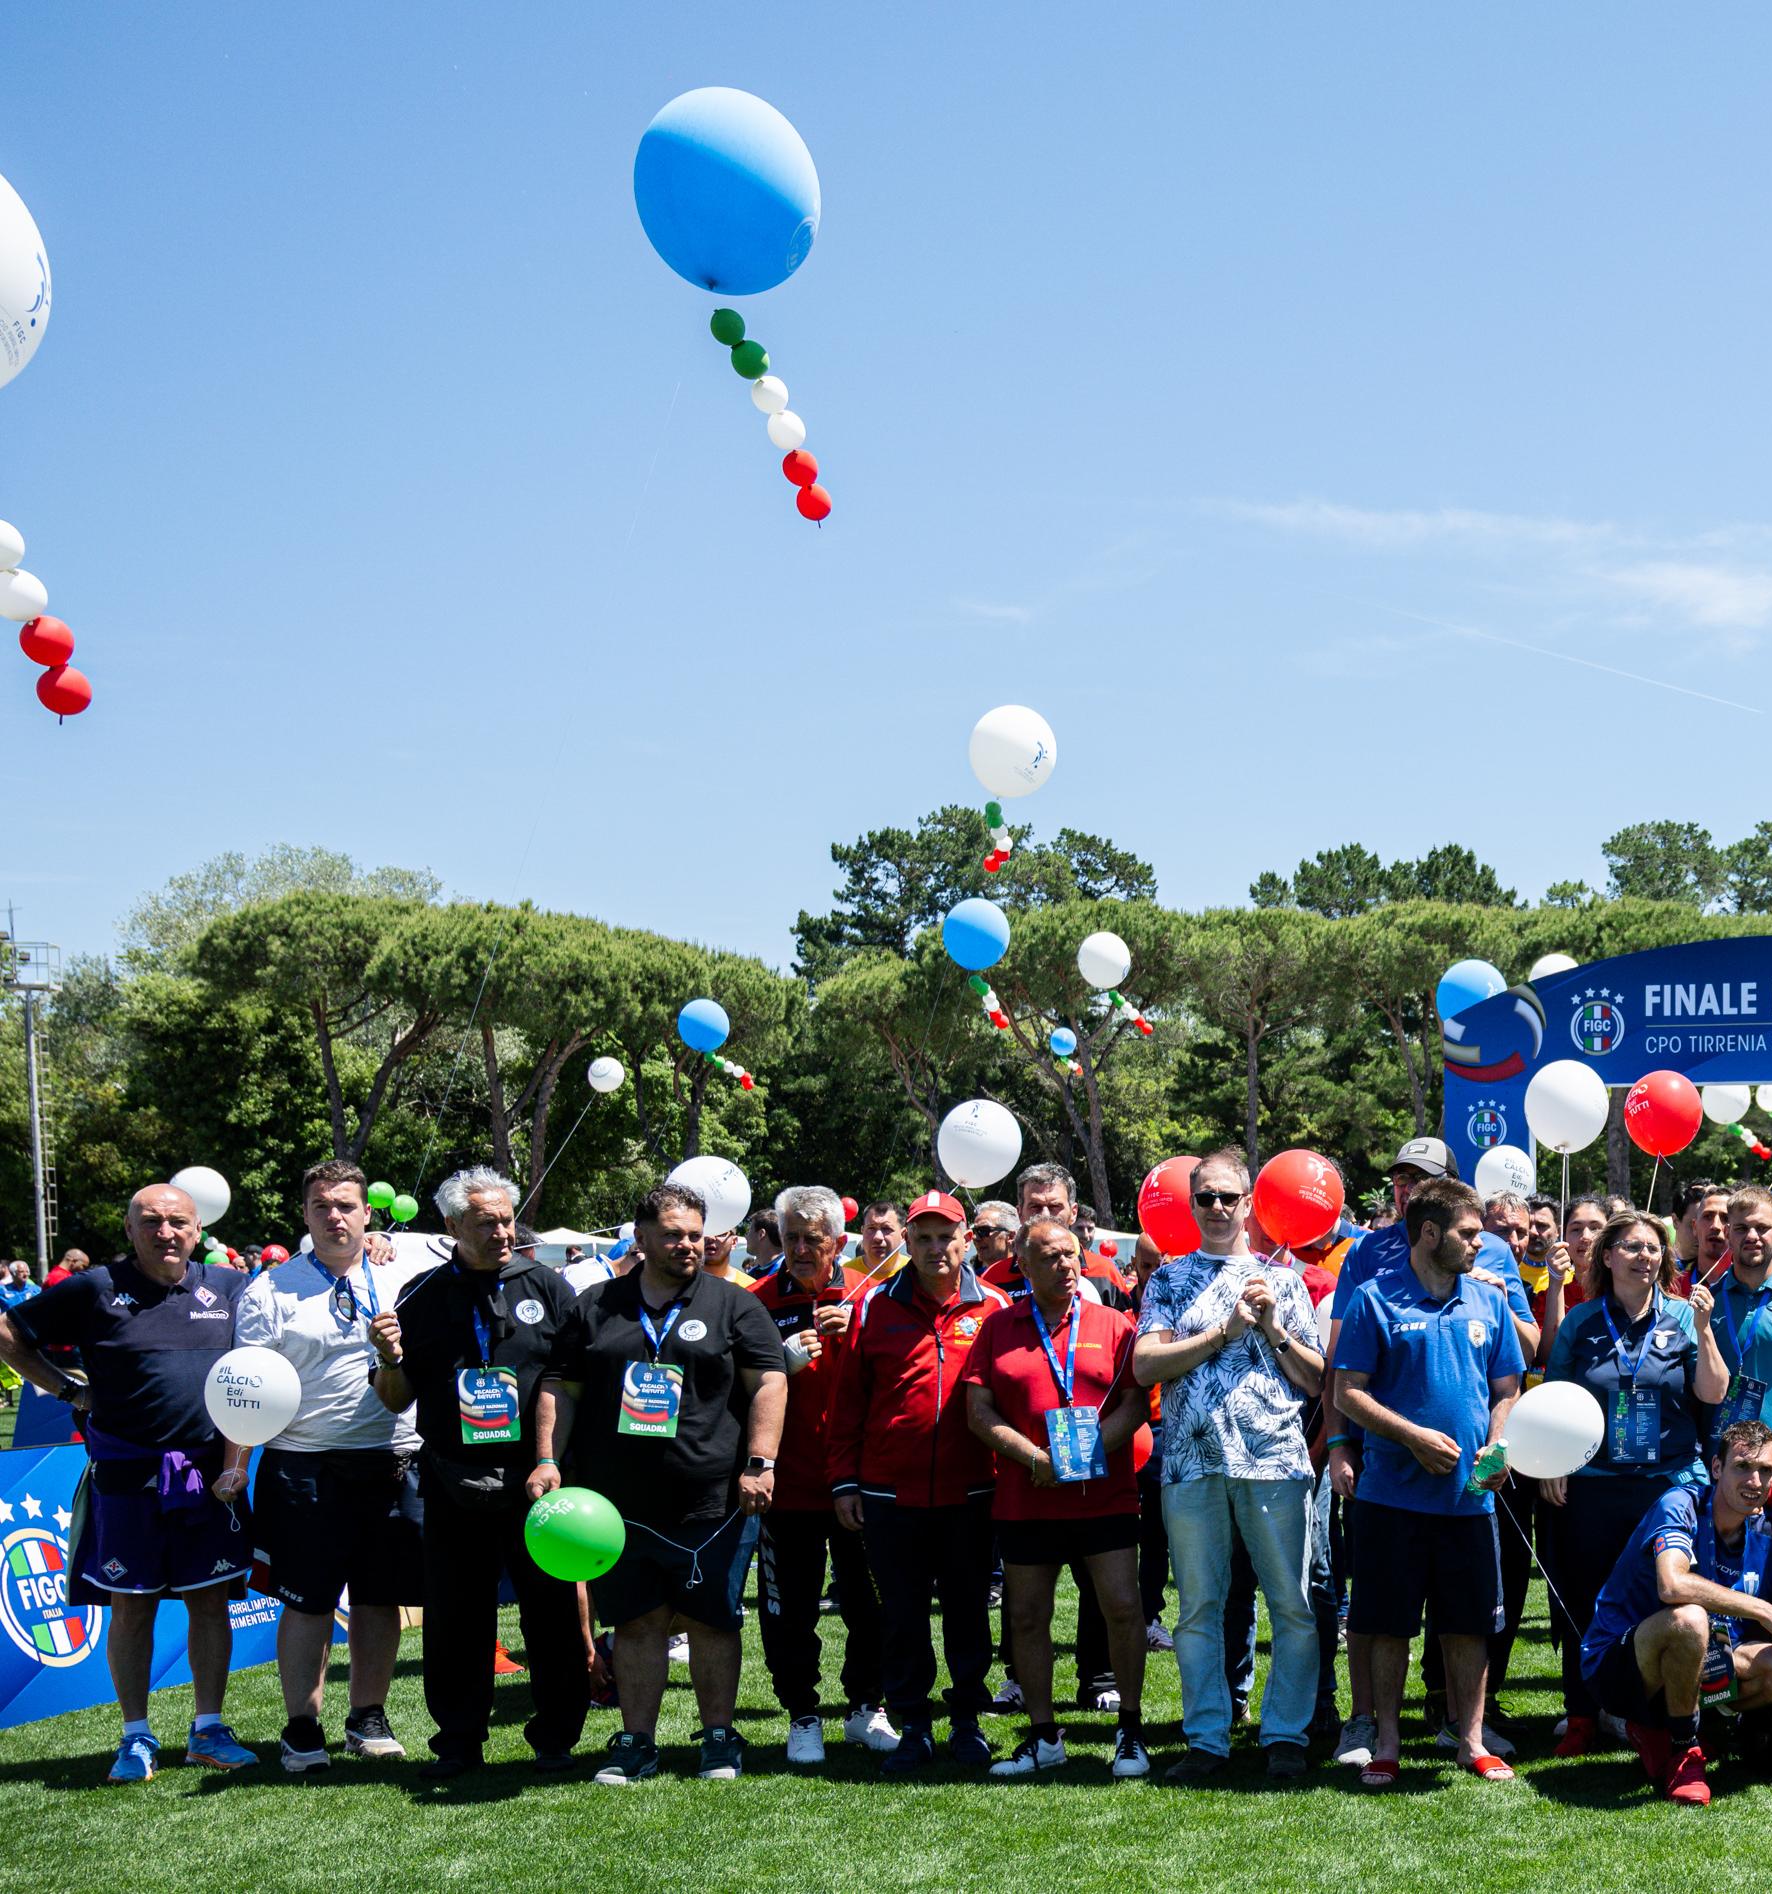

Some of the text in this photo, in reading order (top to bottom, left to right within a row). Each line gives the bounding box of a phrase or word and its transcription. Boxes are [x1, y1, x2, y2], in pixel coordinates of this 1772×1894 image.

[1644, 982, 1758, 1018] FINALE
[1583, 1020, 1612, 1033] FIGC
[1645, 1035, 1682, 1054] CPO
[1688, 1033, 1767, 1053] TIRRENIA
[1477, 1122, 1498, 1134] FIGC
[190, 1310, 229, 1321] Mediacom
[218, 1365, 234, 1377] #IL
[226, 1397, 261, 1410] TUTTI
[629, 1422, 667, 1434] SQUADRA
[472, 1429, 512, 1442] SQUADRA
[17, 1572, 68, 1611] FIGC
[43, 1607, 65, 1620] ITALIA
[1703, 1690, 1732, 1705] SQUADRA
